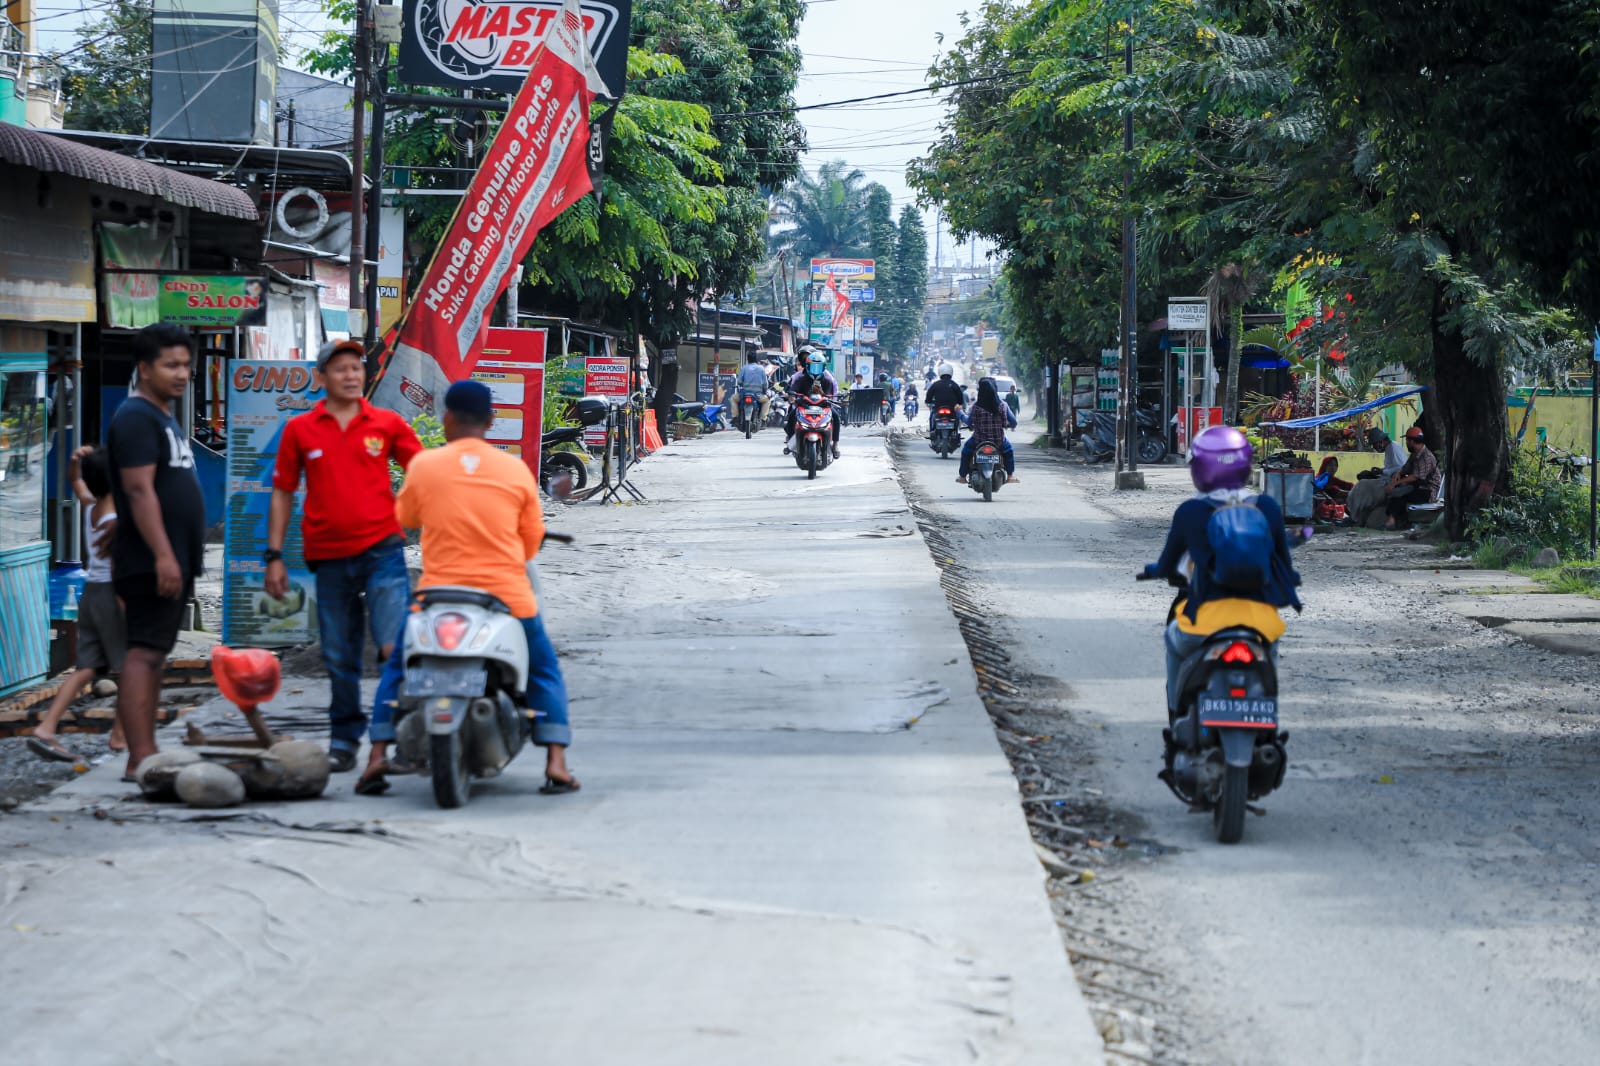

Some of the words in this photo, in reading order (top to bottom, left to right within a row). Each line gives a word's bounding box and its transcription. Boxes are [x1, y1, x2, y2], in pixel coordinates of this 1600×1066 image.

[424, 237, 473, 312] Honda
[466, 140, 521, 233] Genuine
[514, 73, 554, 139] Parts
[441, 284, 468, 325] Suku
[464, 225, 502, 284] Cadang
[493, 193, 511, 227] Asli
[506, 147, 538, 198] Motor
[532, 97, 560, 150] Honda
[163, 281, 208, 292] CINDY
[187, 295, 260, 309] SALON
